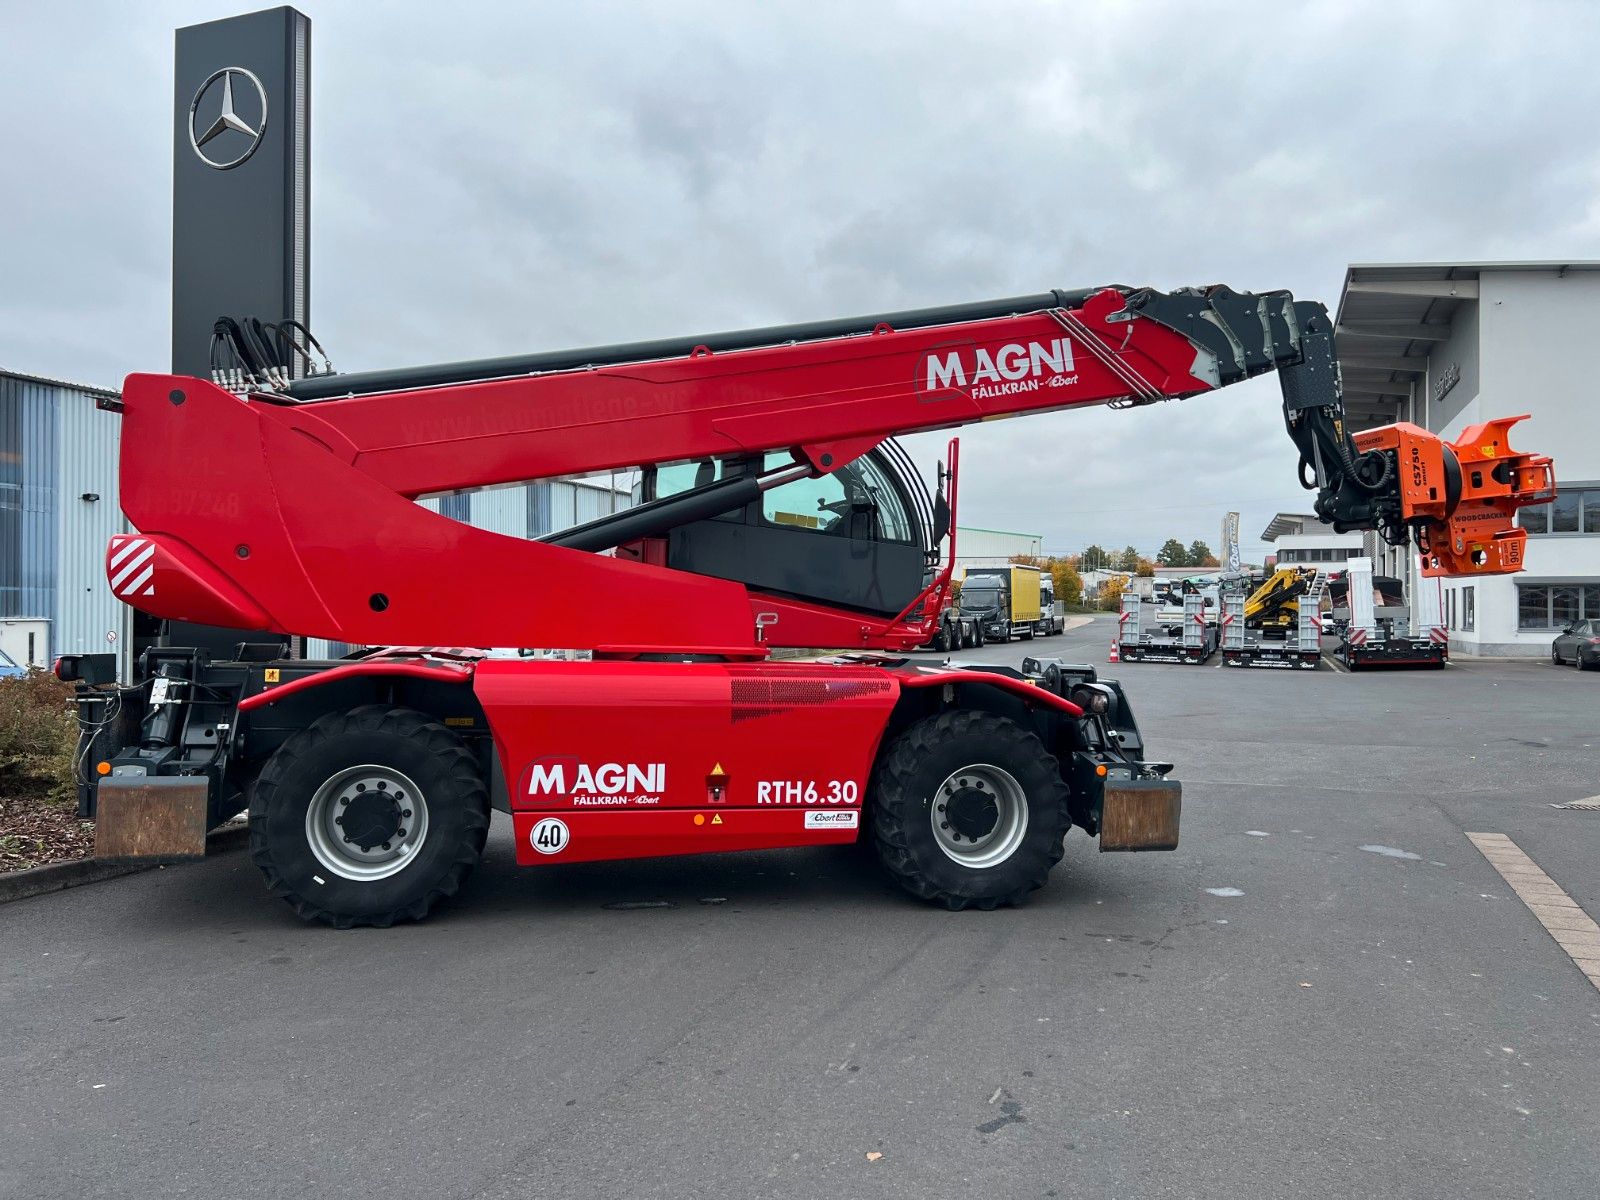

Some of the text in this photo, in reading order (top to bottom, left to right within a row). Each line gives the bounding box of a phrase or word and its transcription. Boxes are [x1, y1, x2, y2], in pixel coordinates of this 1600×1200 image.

[1411, 447, 1422, 487] CS750
[1455, 512, 1507, 523] WOODCRACKER
[1510, 541, 1519, 563] 90m
[756, 780, 858, 804] RTH6.30
[814, 813, 836, 822] Ebert
[537, 825, 560, 848] 40
